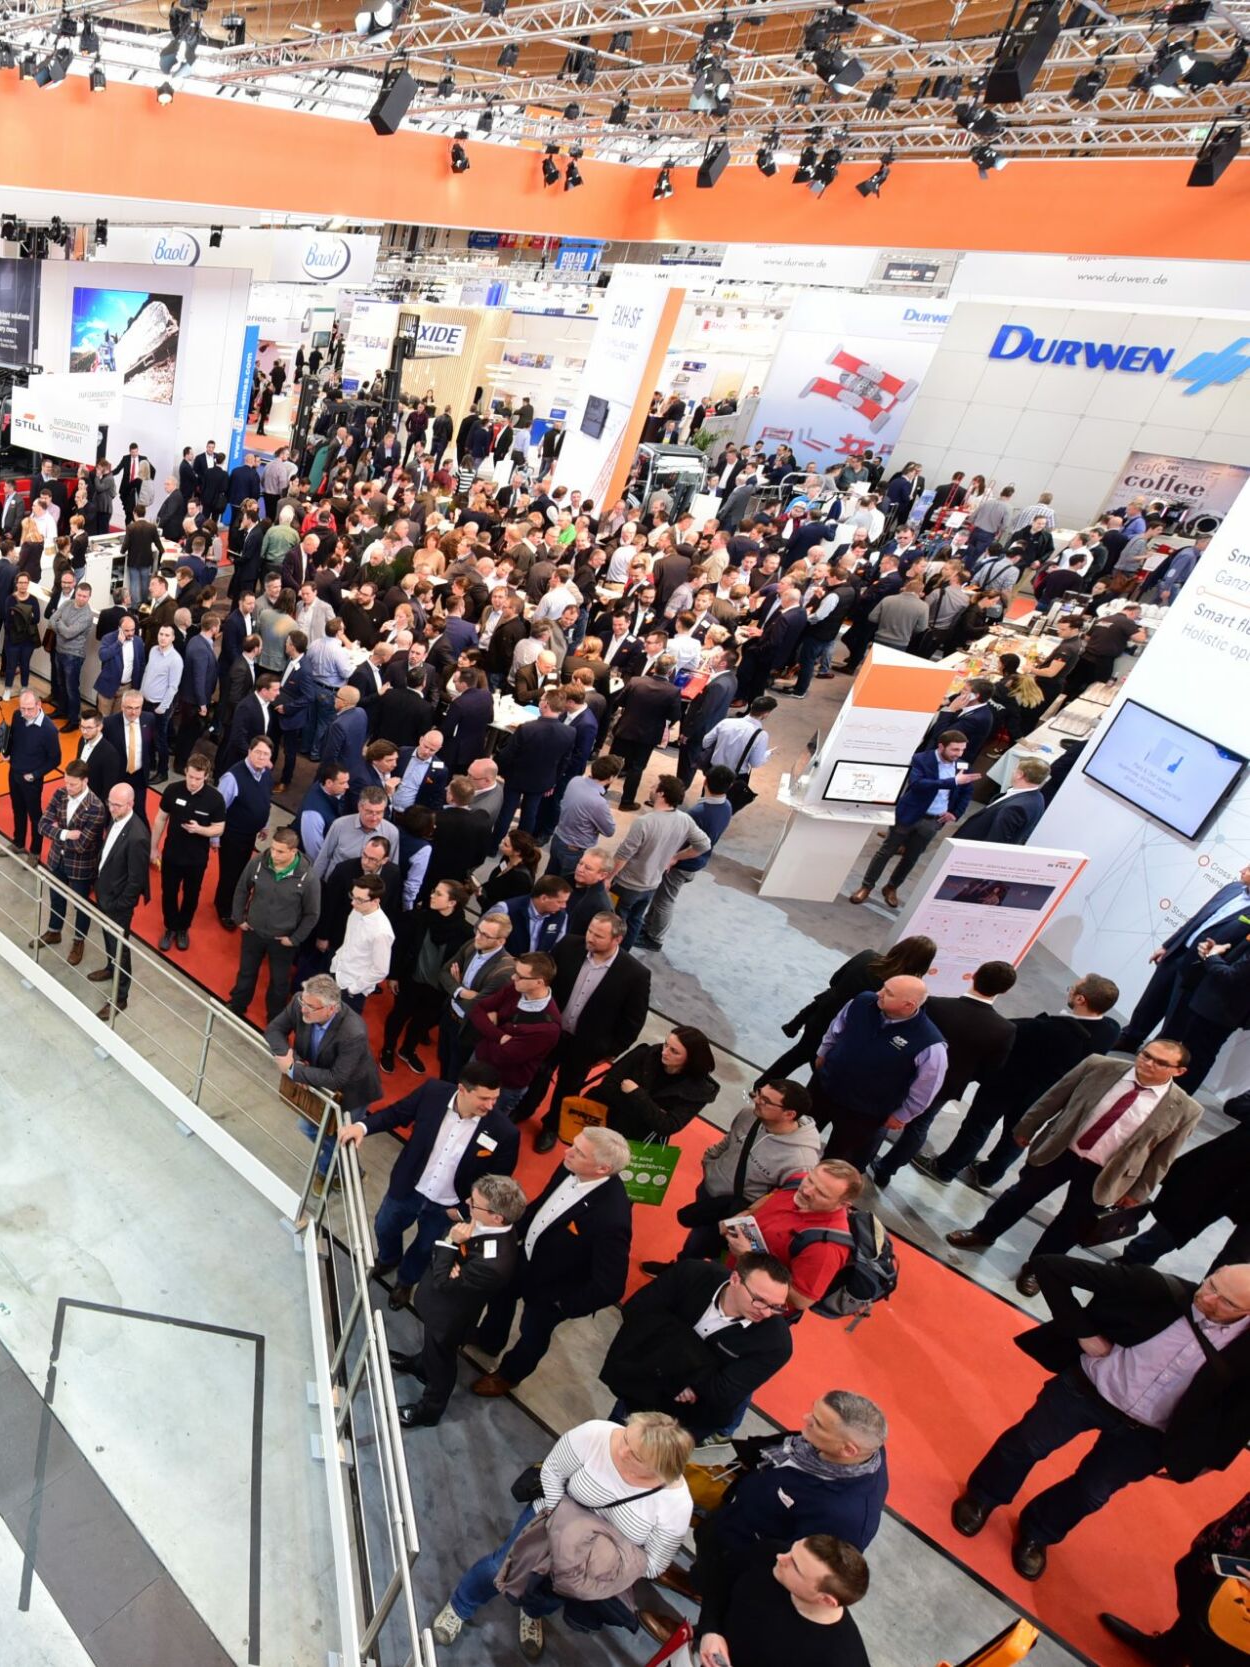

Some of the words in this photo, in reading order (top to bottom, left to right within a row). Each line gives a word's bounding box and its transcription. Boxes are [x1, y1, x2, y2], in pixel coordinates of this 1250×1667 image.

[154, 236, 190, 261] Baoli
[305, 242, 342, 268] Baoli
[562, 251, 588, 263] ROAD
[763, 257, 827, 269] www.durwen.de
[1077, 272, 1168, 285] www.durwen.de
[902, 308, 951, 324] DURWE
[417, 325, 462, 344] XIDE
[988, 324, 1176, 375] DURWEN
[15, 418, 44, 433] STILL
[53, 418, 90, 433] INFORMATION
[1124, 473, 1205, 498] coffee
[1194, 602, 1236, 628] Smart
[1181, 623, 1229, 651] Holistic
